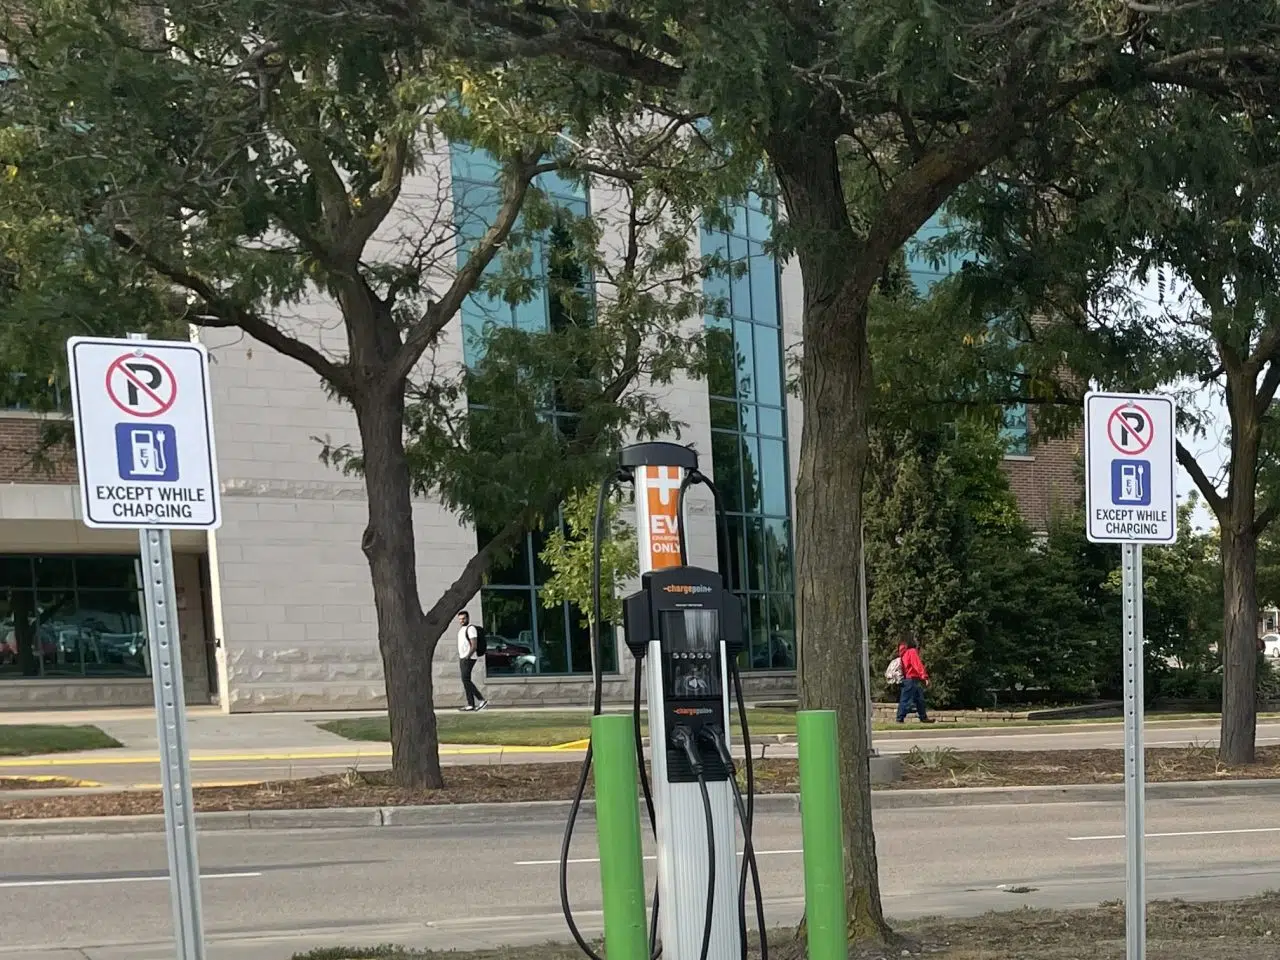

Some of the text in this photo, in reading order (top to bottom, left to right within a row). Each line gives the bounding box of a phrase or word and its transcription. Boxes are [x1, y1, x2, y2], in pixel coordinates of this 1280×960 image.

[96, 485, 206, 503] EXCEPT WHILE
[112, 503, 193, 519] CHARGING
[1096, 509, 1168, 522] EXCEPT WHILE
[651, 514, 678, 534] EV
[1105, 522, 1158, 535] CHARGING
[652, 542, 681, 553] ONLY
